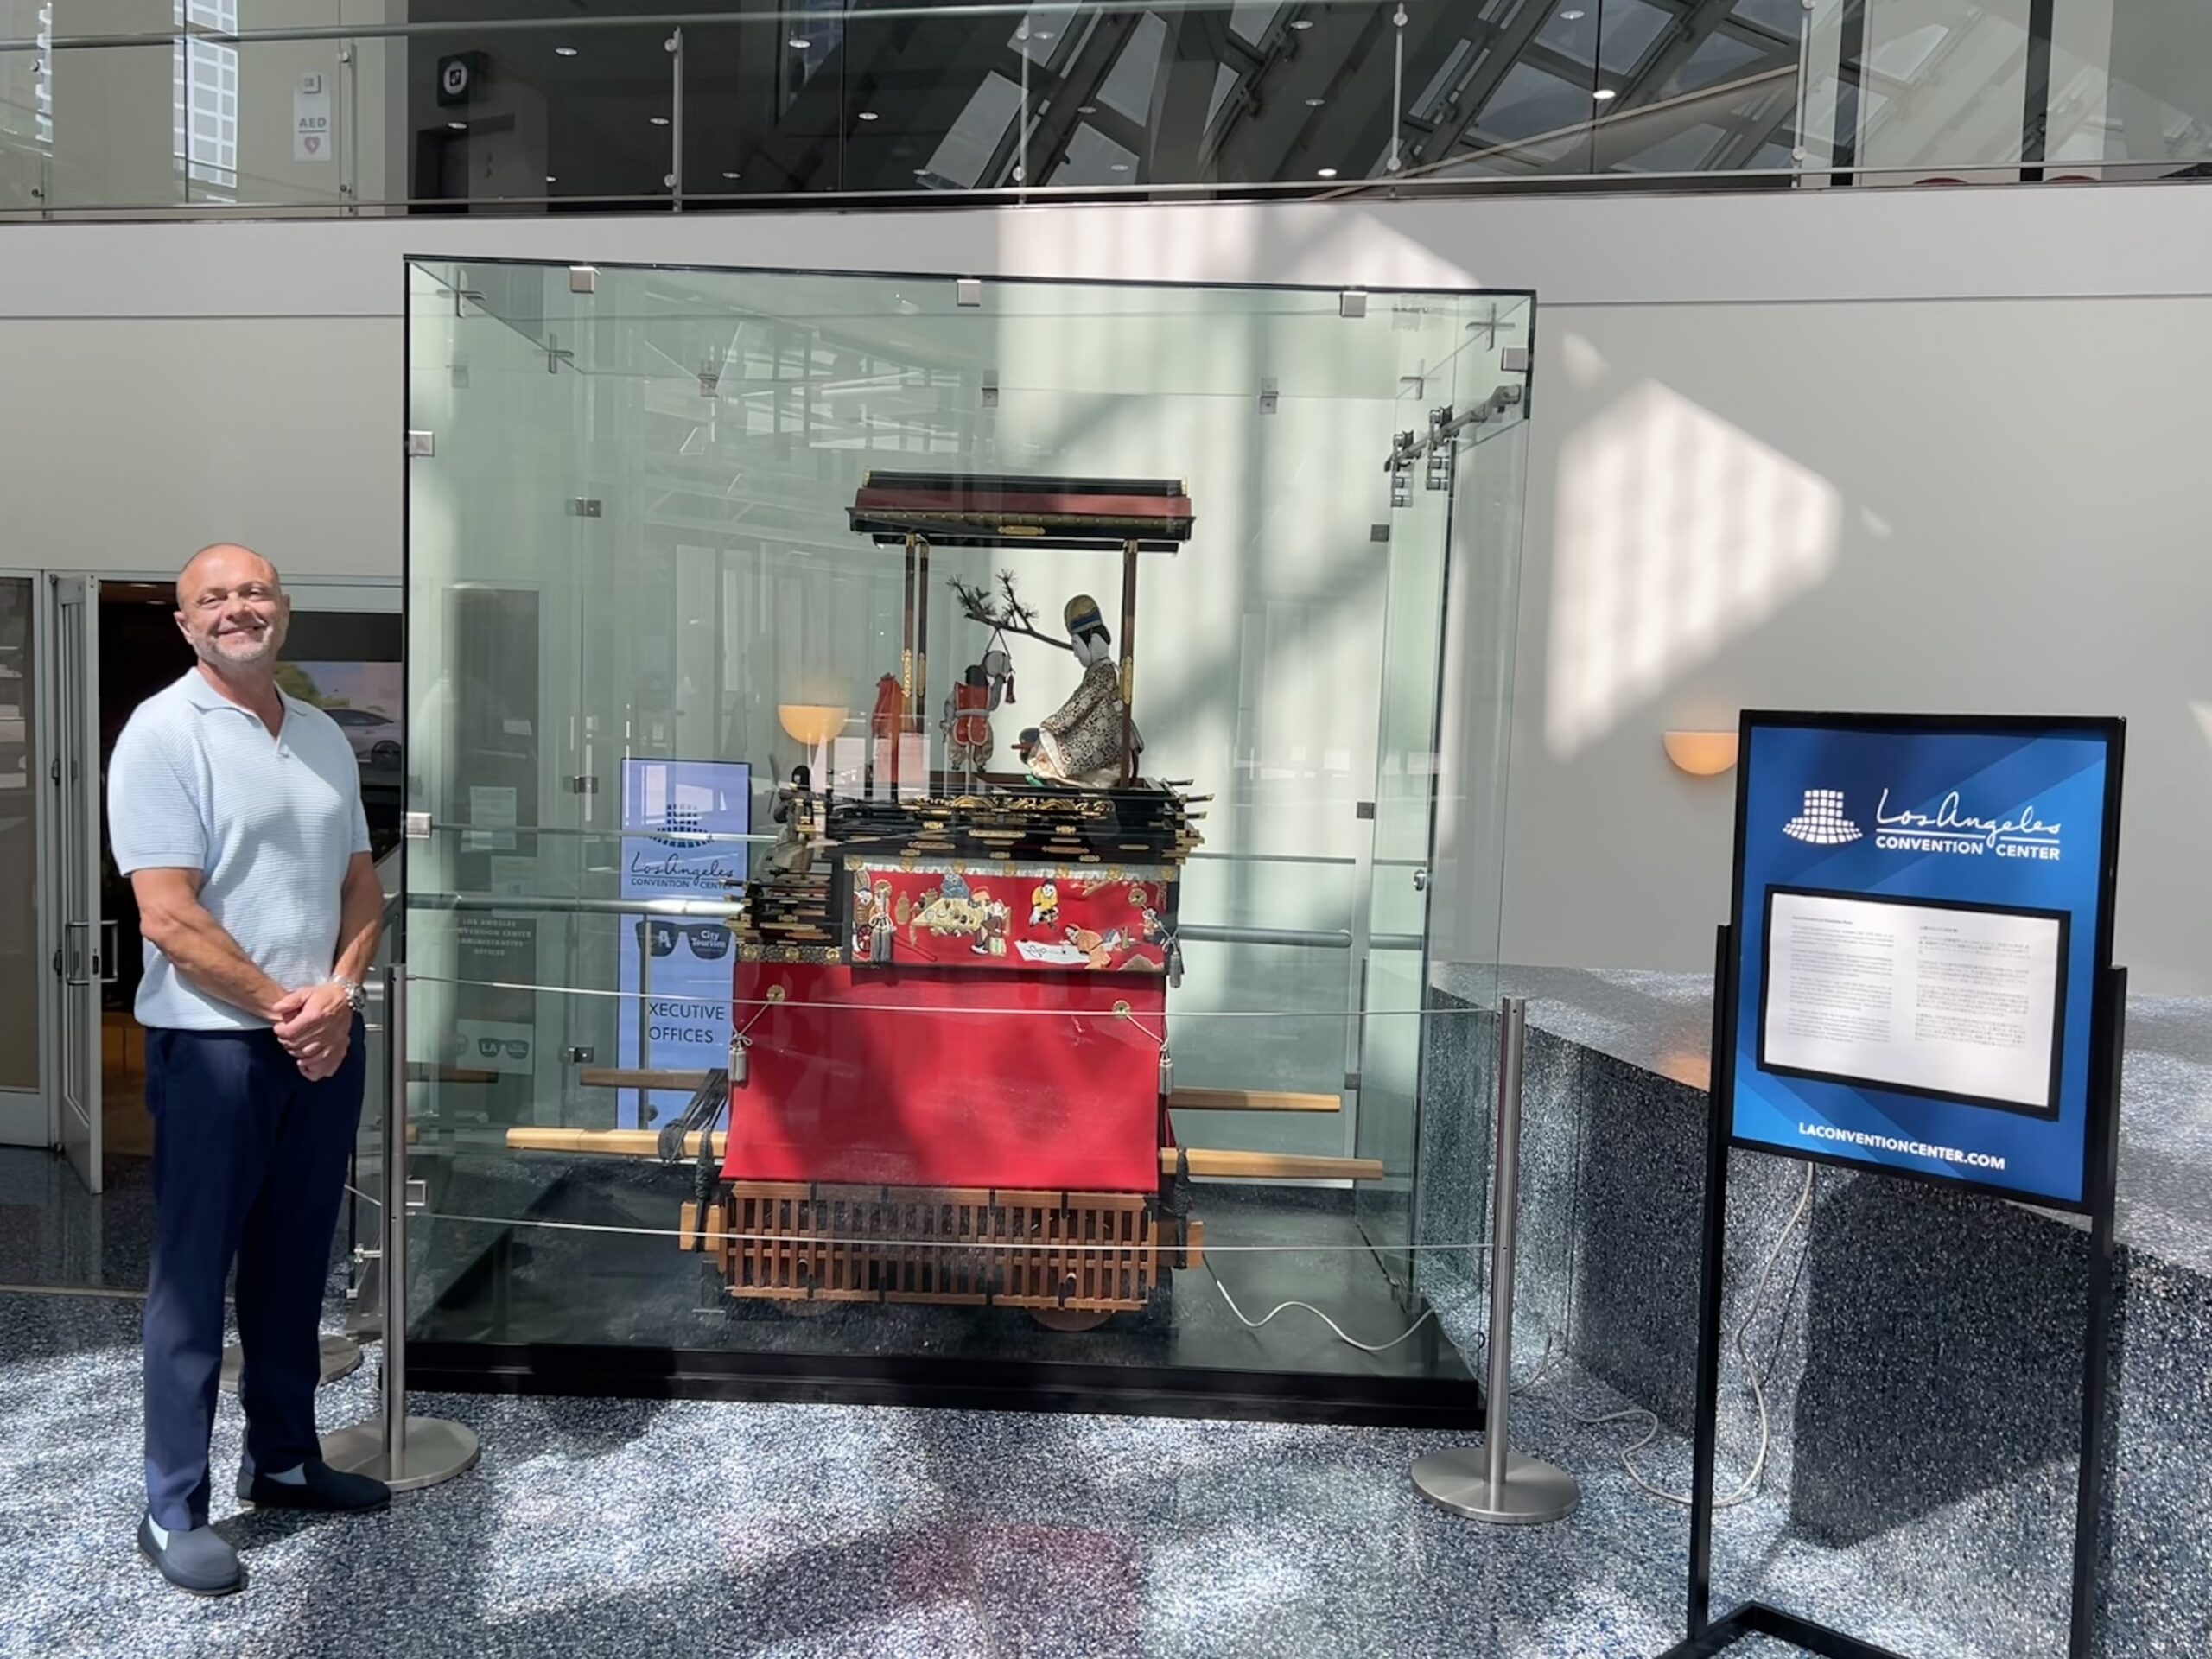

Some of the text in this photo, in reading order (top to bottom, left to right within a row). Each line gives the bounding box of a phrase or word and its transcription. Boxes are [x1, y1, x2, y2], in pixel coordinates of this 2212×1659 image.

[299, 117, 327, 128] AED
[1876, 788, 2061, 848] Los Angeles
[1876, 836, 2061, 861] CONVENTION CENTER
[631, 851, 734, 887] Los Angeles
[631, 878, 690, 888] CONVENTION
[691, 937, 727, 949] Tourism
[701, 930, 720, 941] City
[648, 1002, 725, 1020] XECUTIVE
[649, 1026, 715, 1044] OFFICES
[1798, 1122, 2006, 1171] LACONVENTIONCENTER.COM
